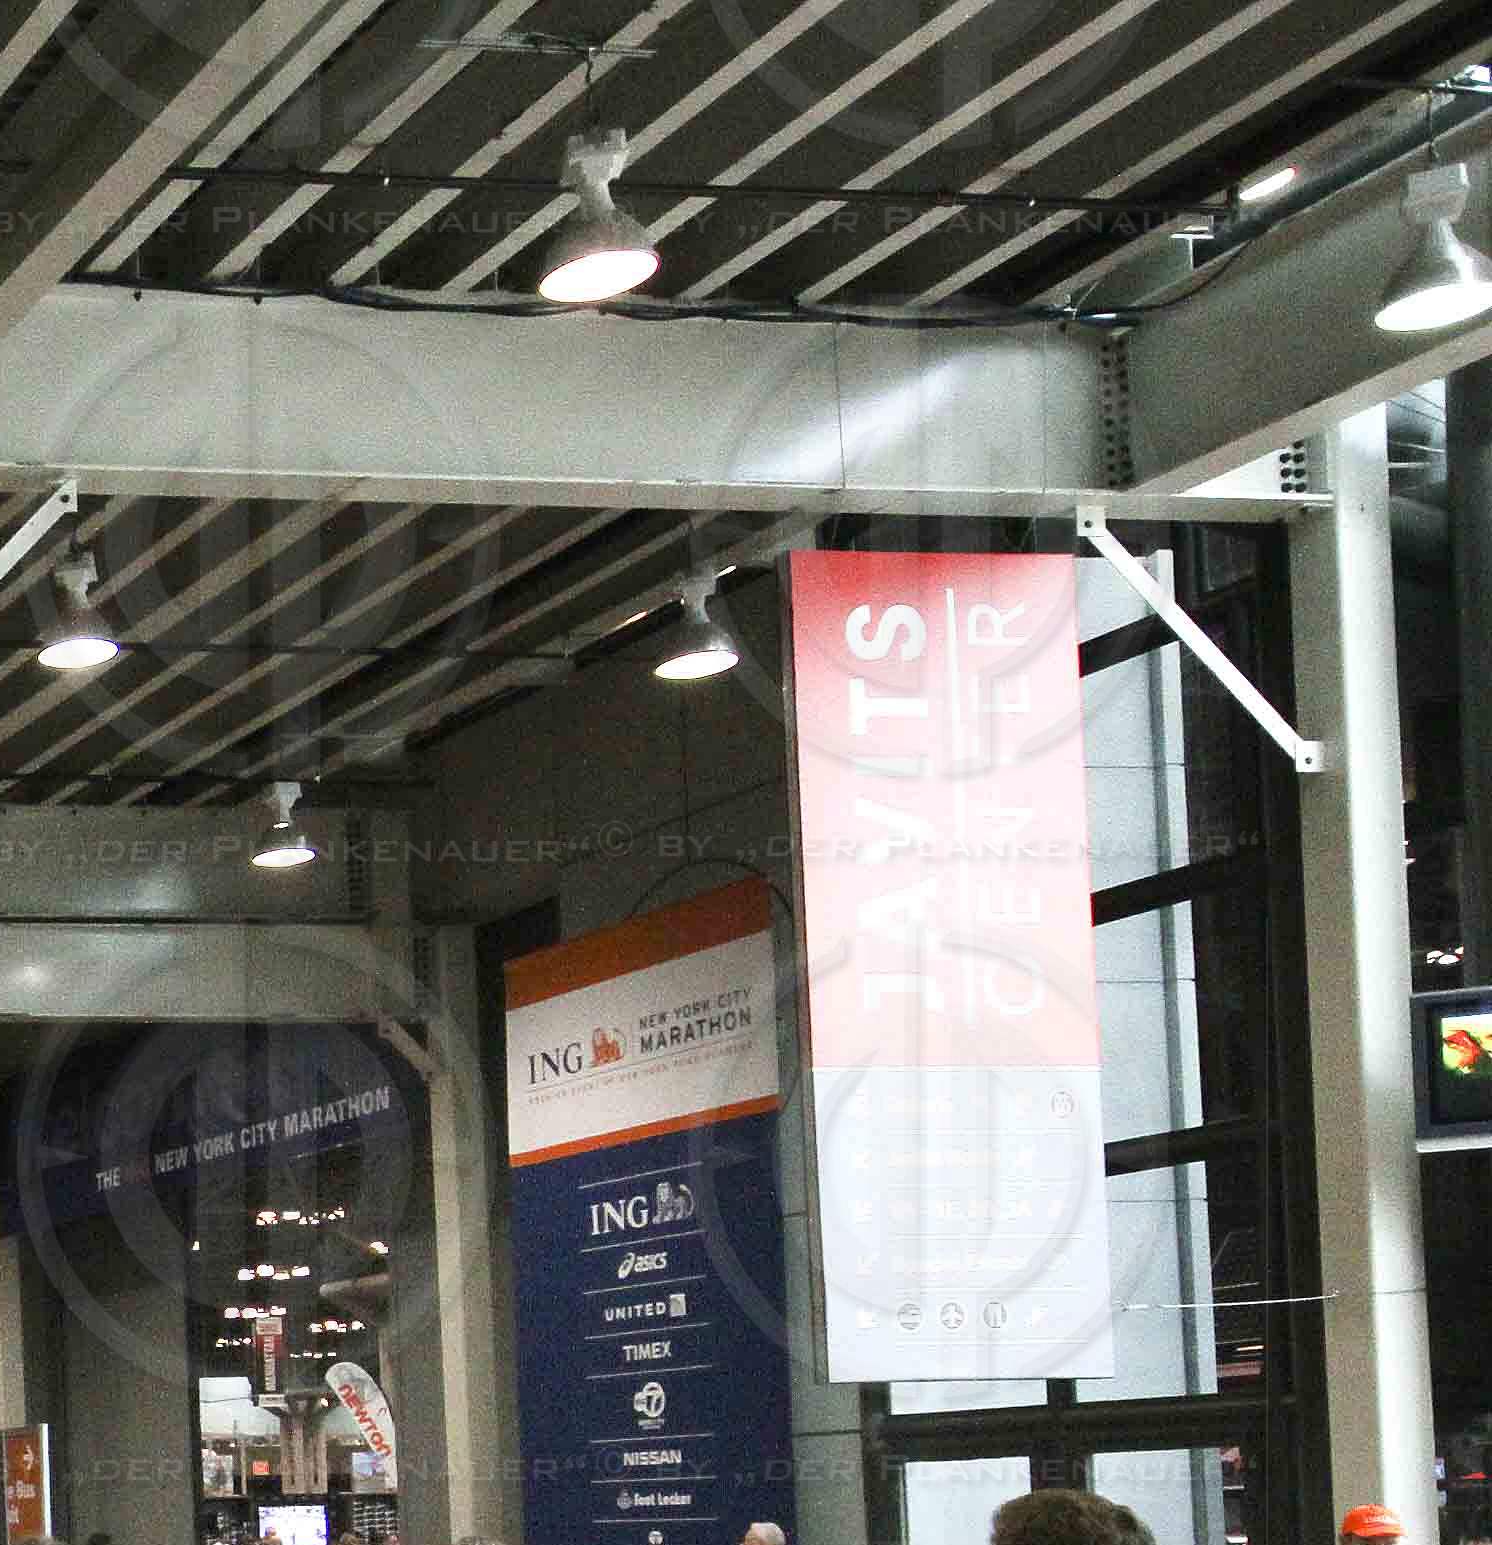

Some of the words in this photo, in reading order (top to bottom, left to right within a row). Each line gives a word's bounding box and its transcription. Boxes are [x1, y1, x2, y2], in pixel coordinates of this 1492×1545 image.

[639, 1007, 753, 1054] MARATHON
[527, 1042, 583, 1086] ING
[95, 1170, 121, 1191] THE
[154, 1149, 191, 1175] NEW
[193, 1133, 235, 1164] YORK
[240, 1118, 278, 1151] CITY
[283, 1086, 392, 1138] MARATHON
[589, 1195, 649, 1237] ING
[603, 1302, 666, 1322] UNITED
[622, 1340, 672, 1361] TIMEX
[622, 1449, 682, 1467] NISSAN
